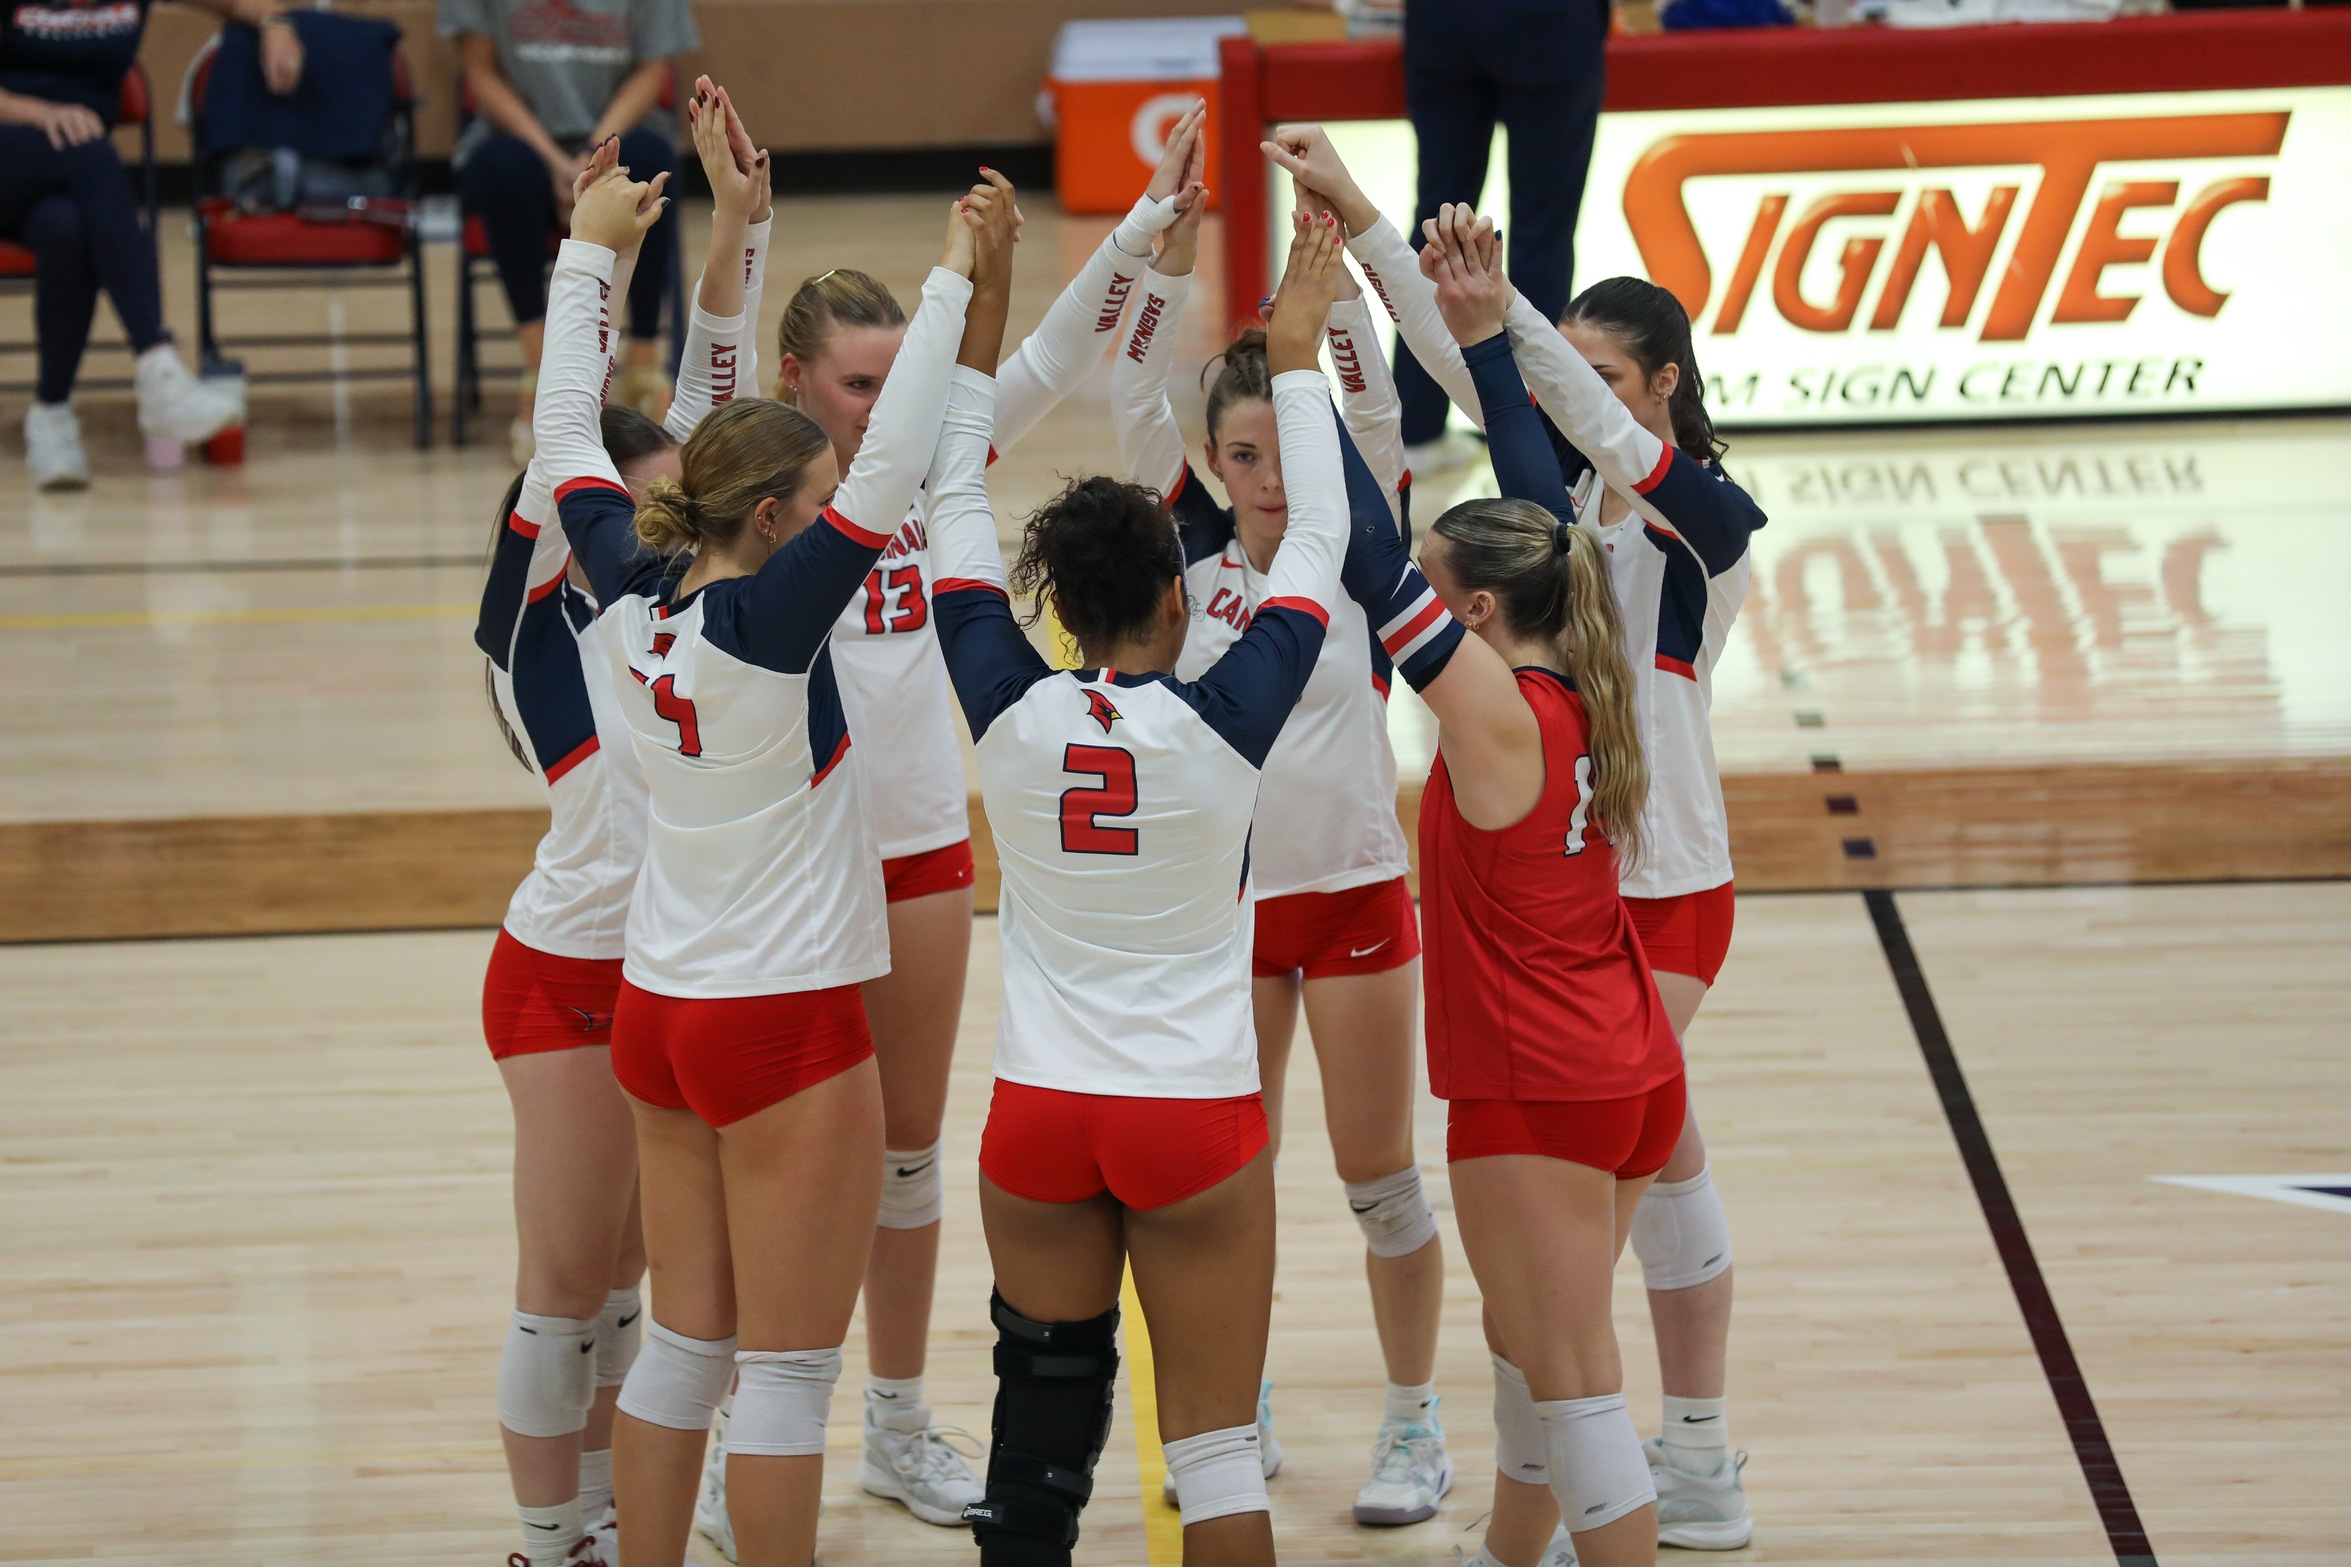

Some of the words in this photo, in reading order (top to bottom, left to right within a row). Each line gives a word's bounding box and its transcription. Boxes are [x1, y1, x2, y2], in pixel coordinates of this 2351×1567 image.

[1094, 271, 1135, 333] VALLEY
[1126, 292, 1166, 364] SAGINAW
[1327, 326, 1367, 393] VALLEY
[1788, 367, 1935, 406] SIGN
[1957, 357, 2205, 401] CENTER
[862, 563, 928, 636] 13
[1058, 742, 1139, 856] 2
